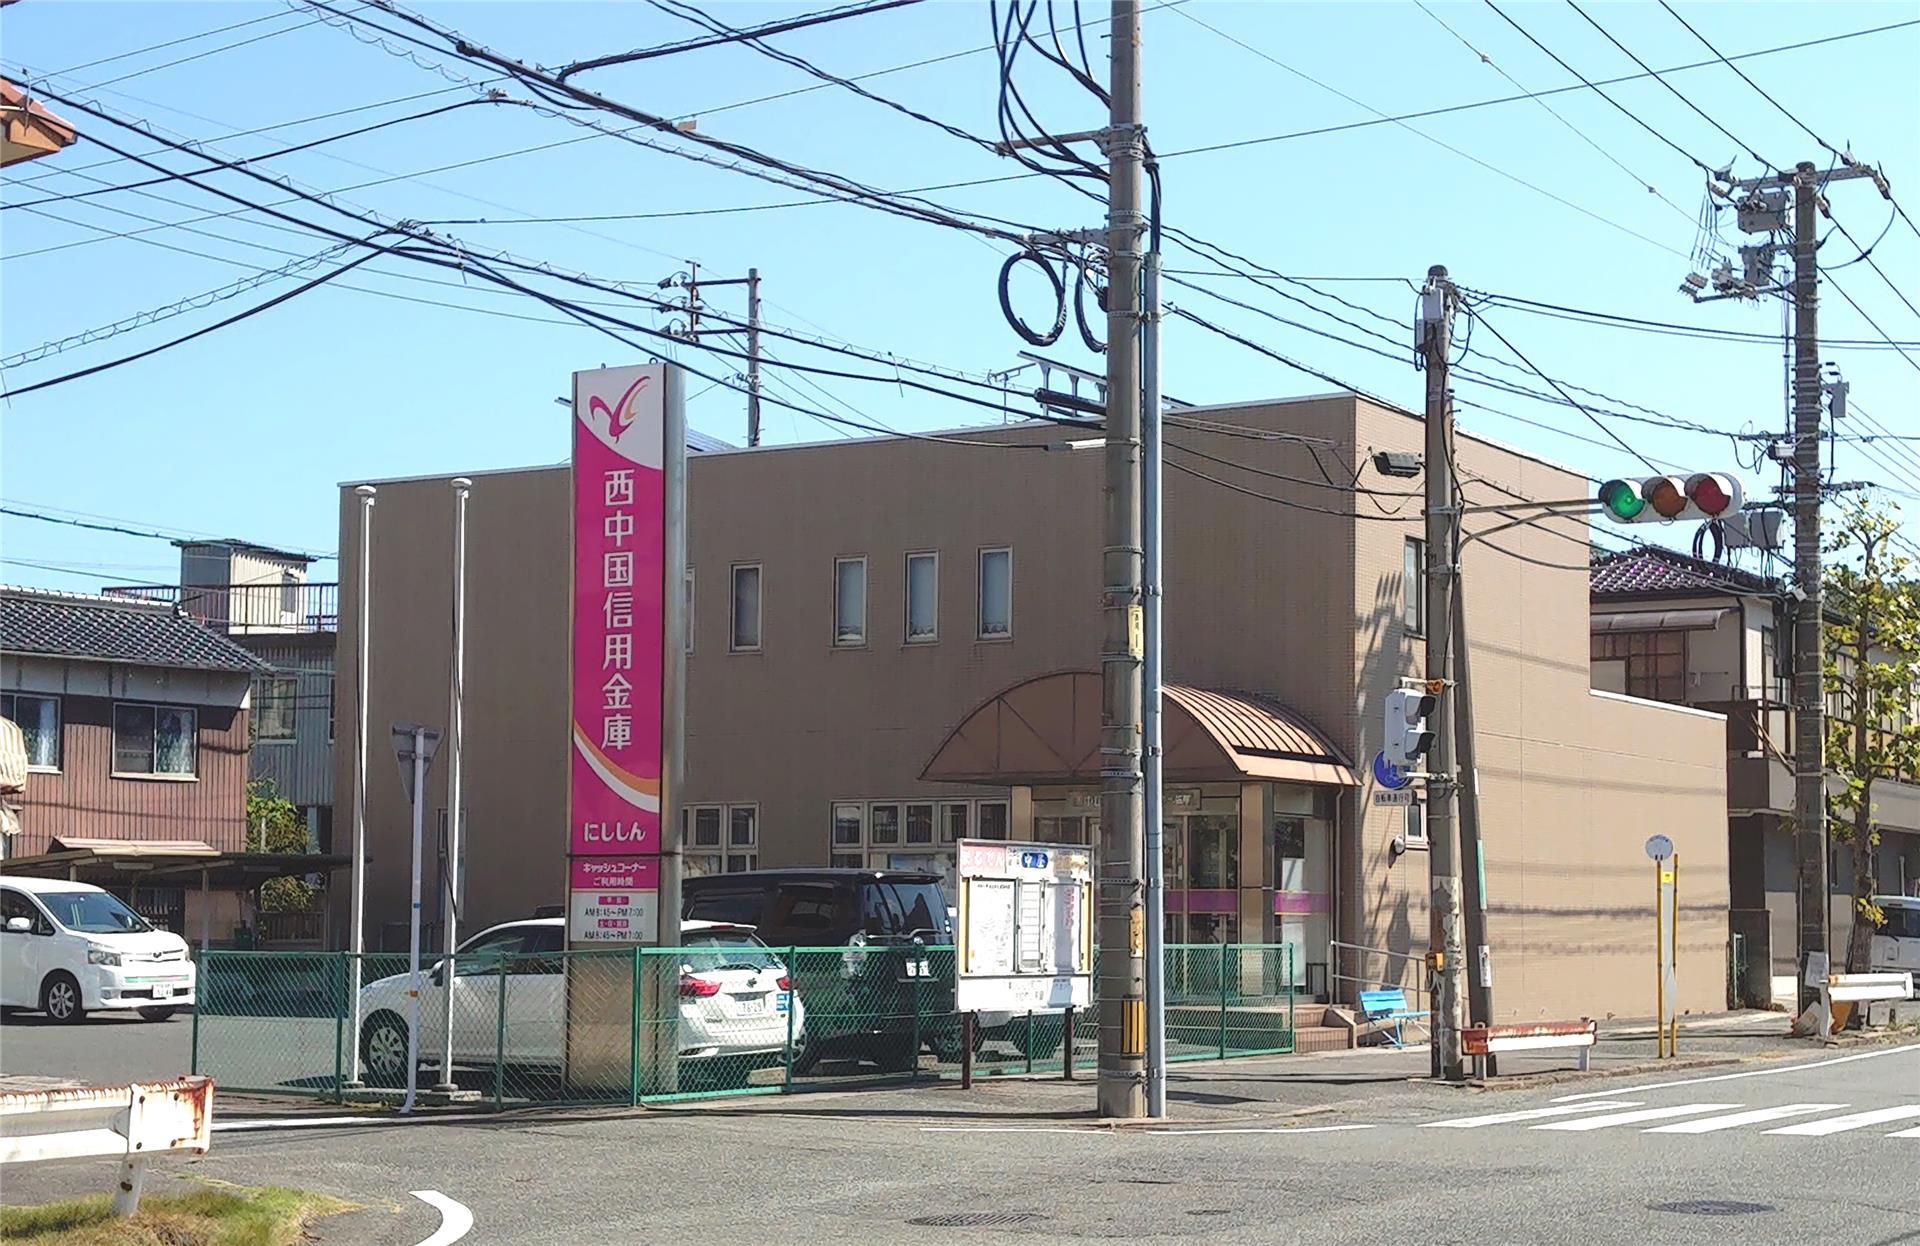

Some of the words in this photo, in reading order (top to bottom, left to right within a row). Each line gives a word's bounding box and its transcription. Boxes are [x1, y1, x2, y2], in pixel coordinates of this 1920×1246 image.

[601, 468, 635, 751] 西中国信用金庫
[584, 822, 646, 842] にししん
[583, 862, 646, 873] キャッシュコーナー
[592, 876, 634, 887] ご利用時間
